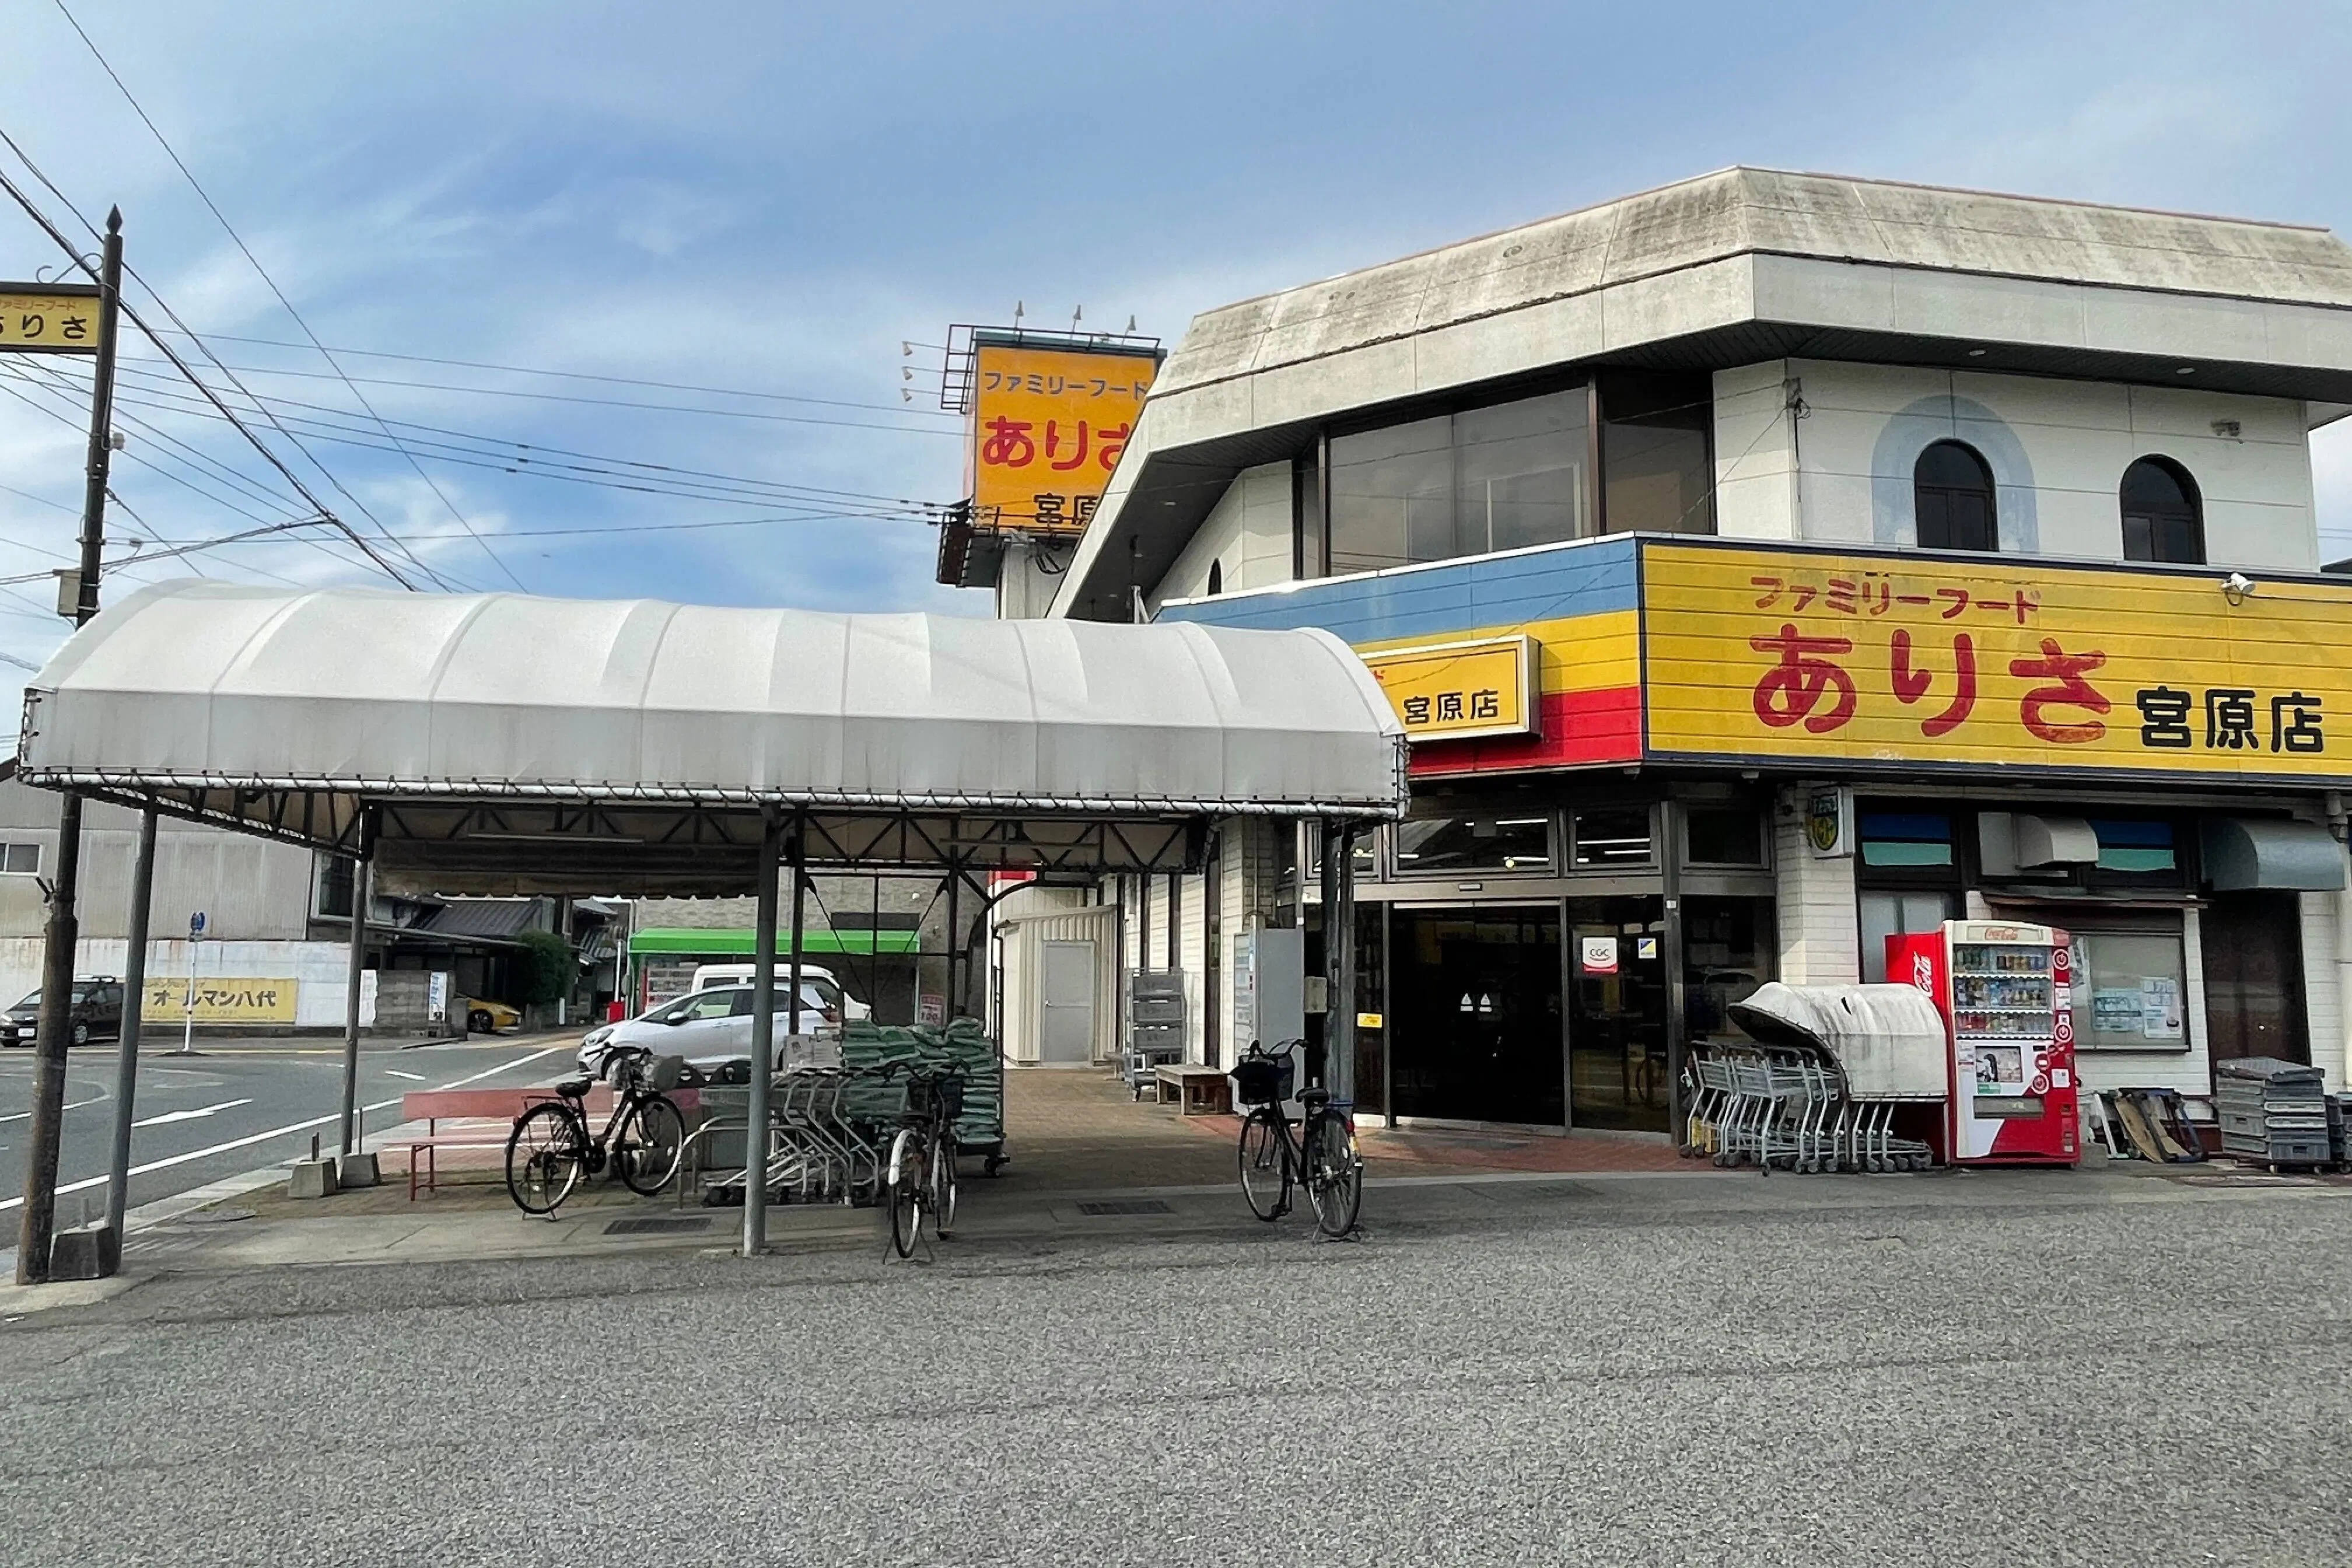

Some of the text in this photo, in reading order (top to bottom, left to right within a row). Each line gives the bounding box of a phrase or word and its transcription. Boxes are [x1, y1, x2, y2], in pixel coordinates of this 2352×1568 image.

[0, 314, 86, 339] りさ
[985, 372, 1147, 401] ファミリーフード
[1751, 576, 2041, 625] ファミリーフード
[1750, 623, 2323, 752] ありさ 宮原店
[1404, 689, 1498, 725] 宮原店
[1590, 949, 1609, 957] CGC
[153, 989, 276, 1007] オールマン八代
